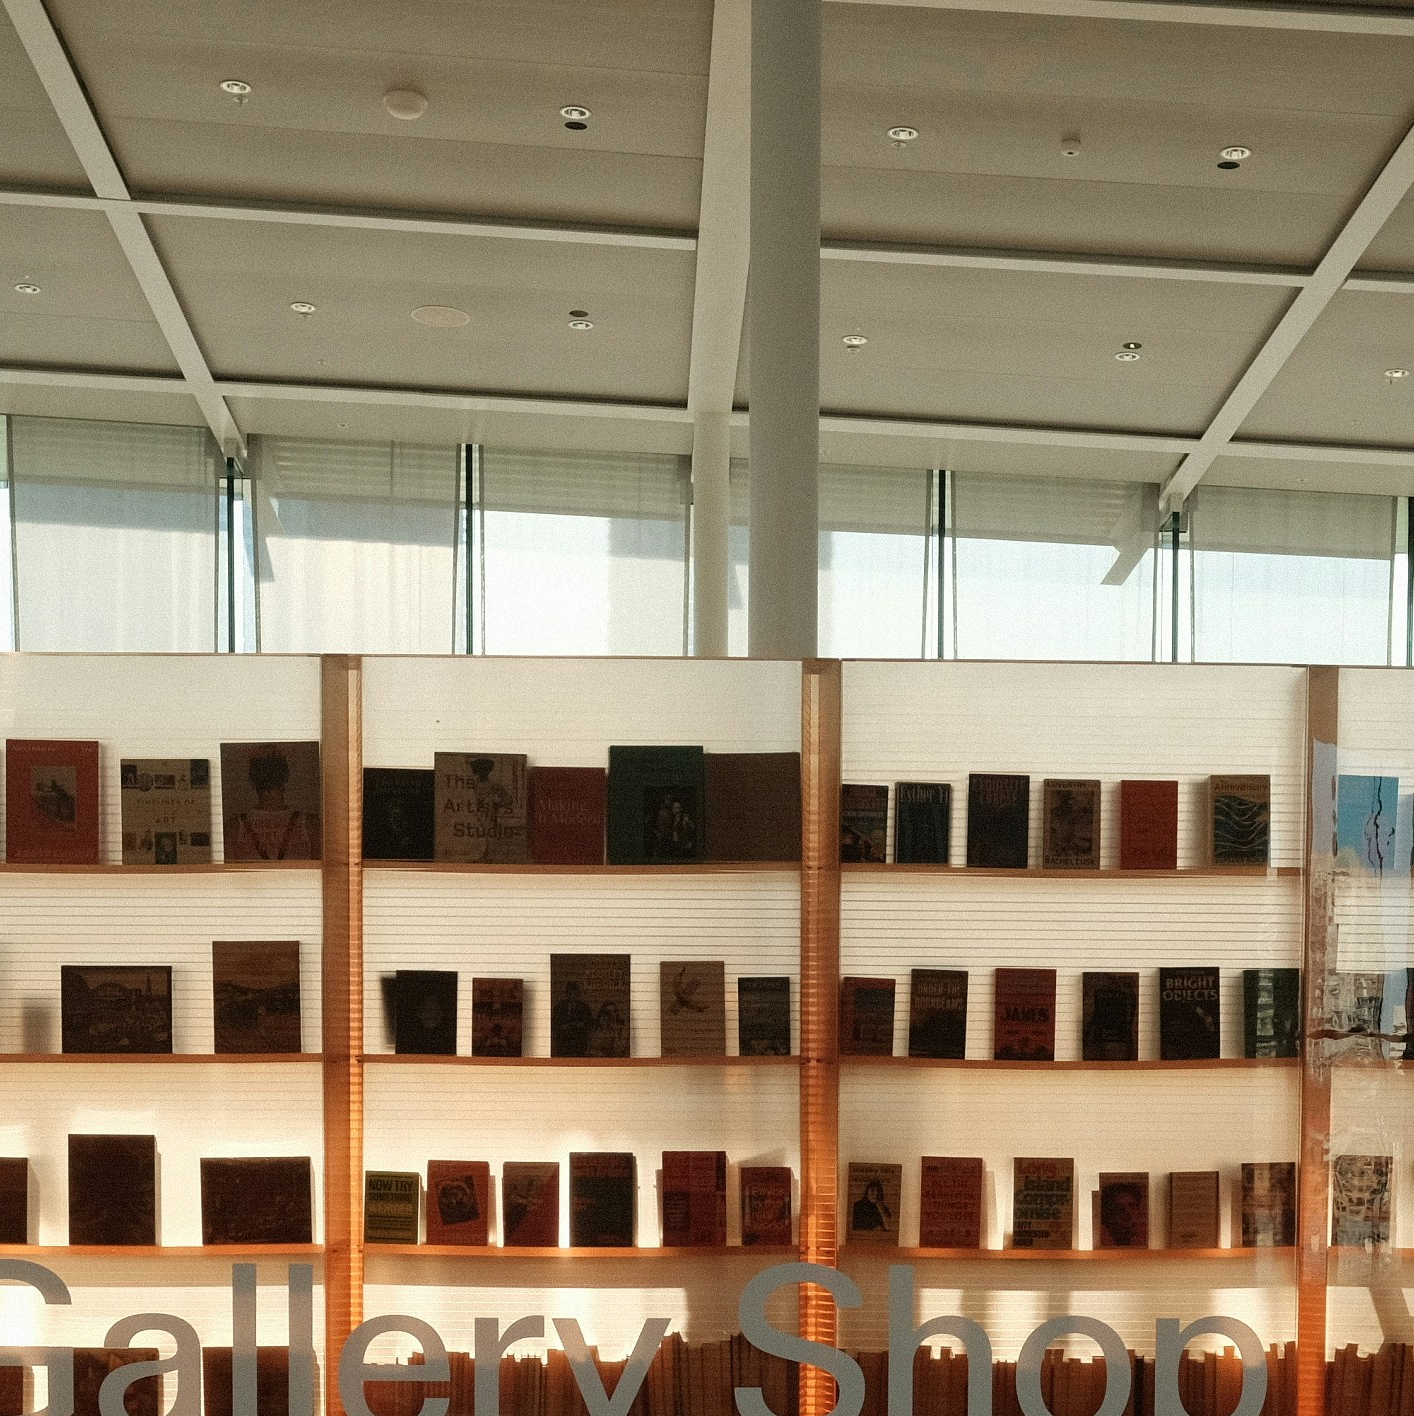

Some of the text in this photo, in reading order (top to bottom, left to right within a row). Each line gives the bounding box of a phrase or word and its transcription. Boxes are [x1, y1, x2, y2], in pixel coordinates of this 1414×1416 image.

[1165, 976, 1216, 989] BRIGHT
[1162, 989, 1218, 1002] OBJECTS
[999, 1007, 1050, 1023] JAMES
[368, 1179, 414, 1192] NOW TRY
